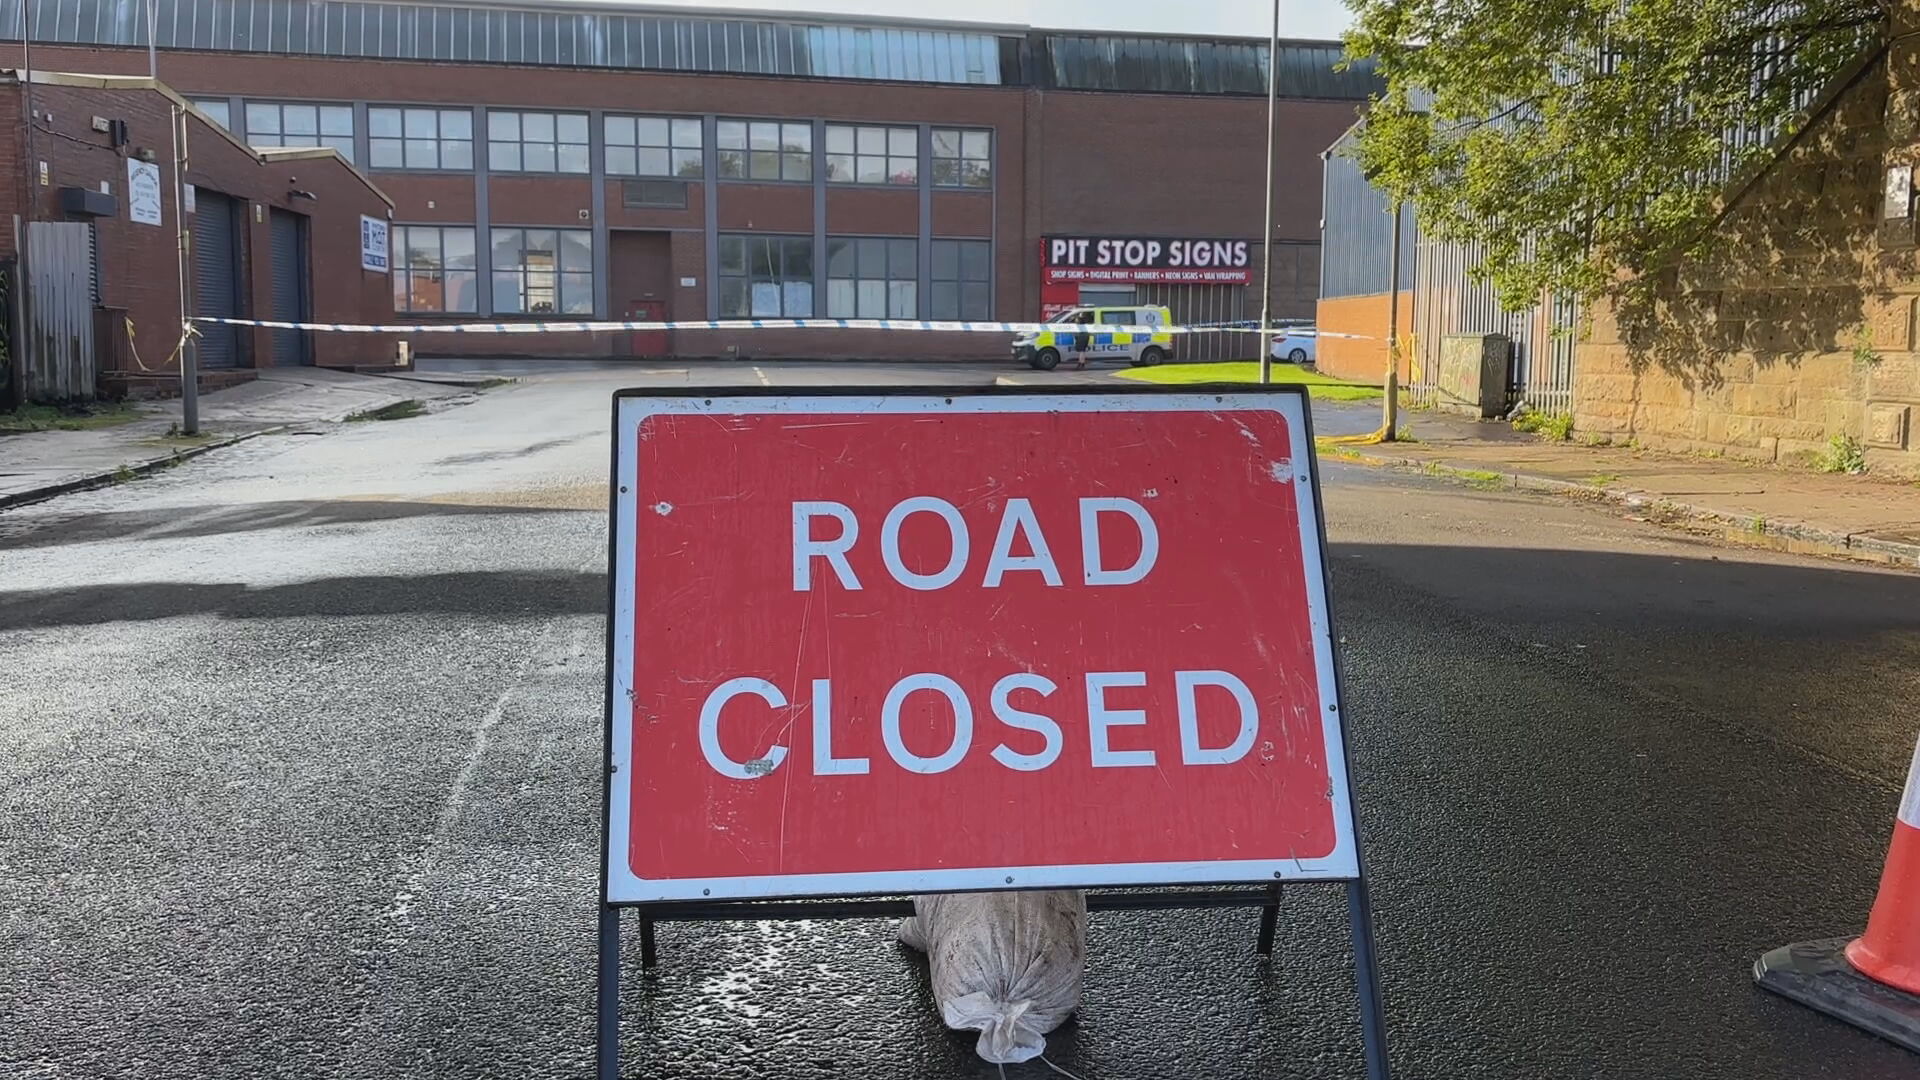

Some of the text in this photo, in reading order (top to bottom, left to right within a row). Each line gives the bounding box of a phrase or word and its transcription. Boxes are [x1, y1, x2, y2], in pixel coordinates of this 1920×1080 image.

[1050, 270, 1246, 280] SHOP SIGNS DIGITAL PRINT BANNERS NEON SIGNS VAN WRAPPING
[1051, 239, 1089, 265] PIT
[1096, 239, 1161, 266] STOP
[1168, 240, 1248, 267] SIGNS
[791, 495, 1161, 592] ROAD
[698, 669, 1260, 780] CLOSED
